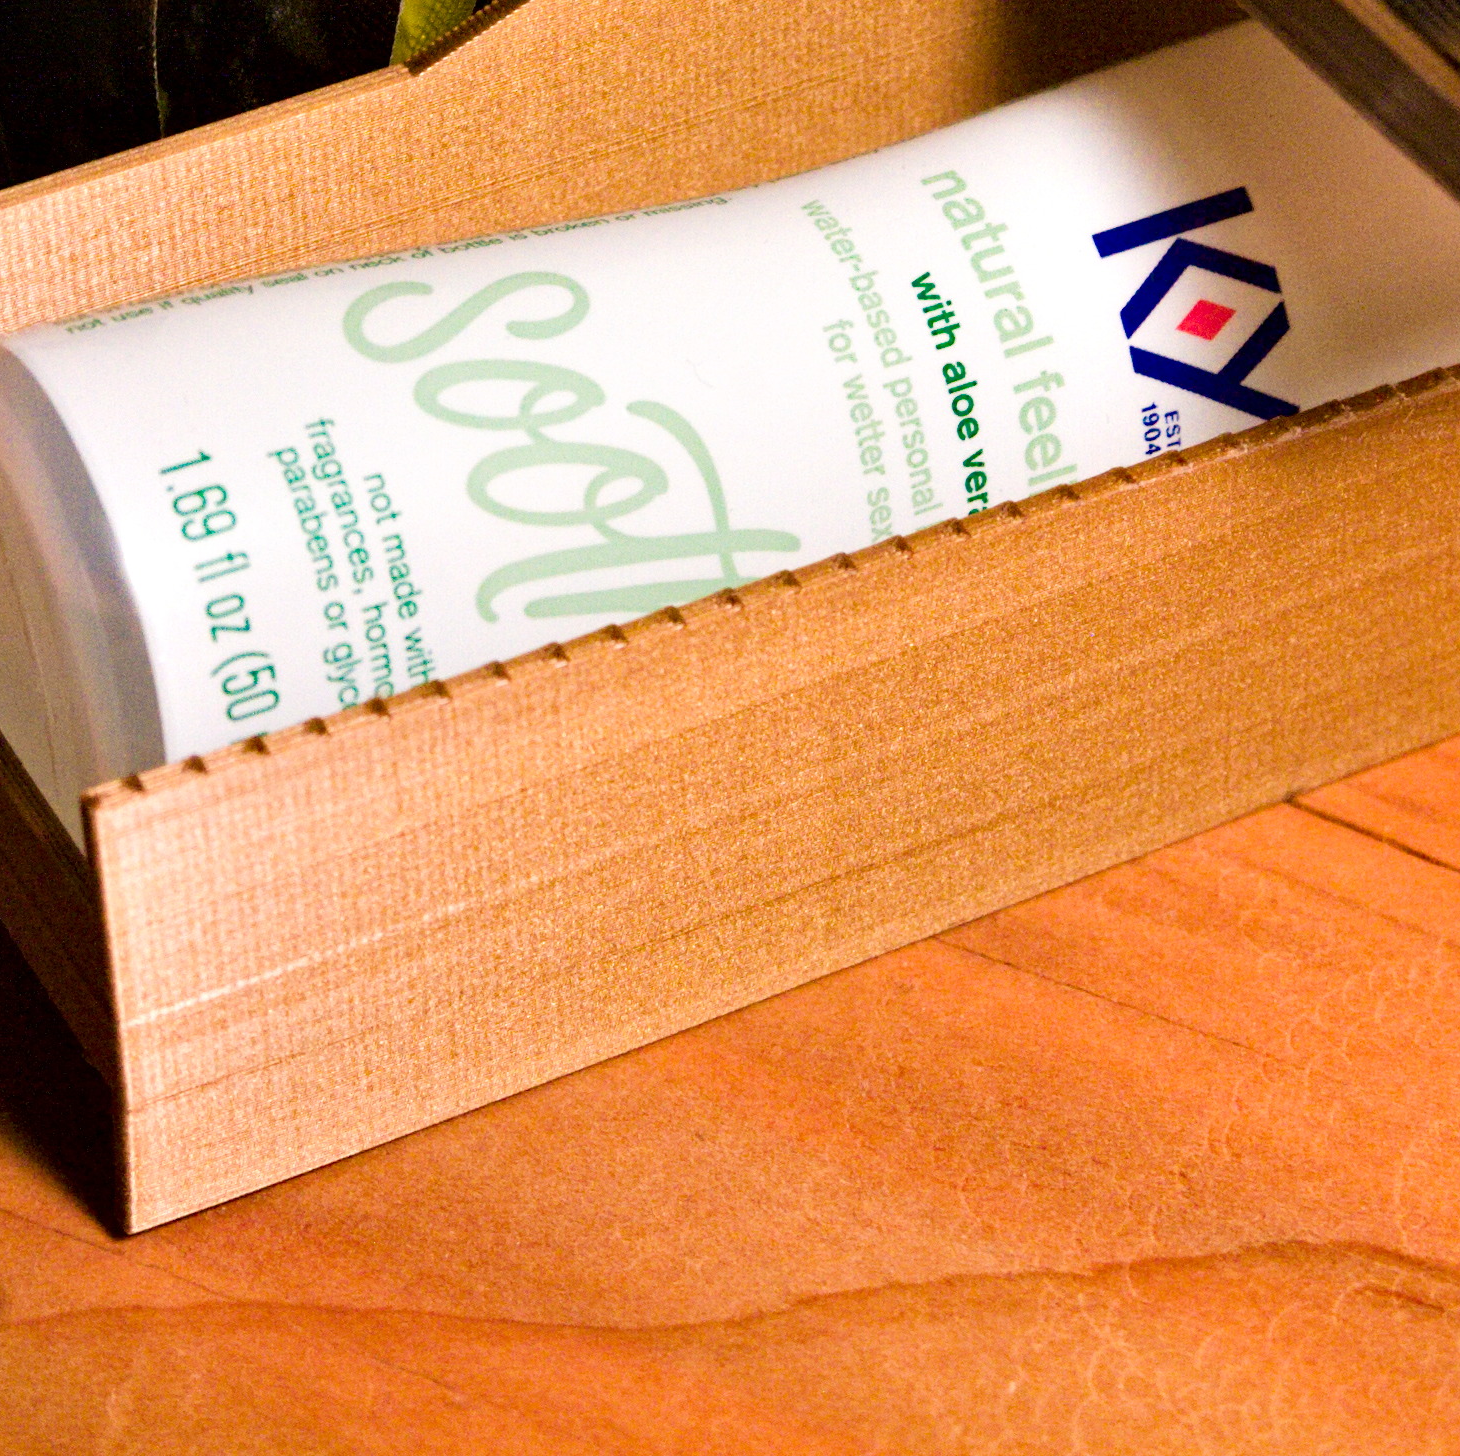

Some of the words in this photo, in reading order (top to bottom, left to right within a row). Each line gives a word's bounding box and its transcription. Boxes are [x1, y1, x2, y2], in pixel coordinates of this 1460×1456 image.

[530, 217, 610, 238] broken
[801, 199, 912, 369] water-based
[883, 377, 944, 516] personal
[911, 272, 960, 350] with
[942, 360, 977, 441] aloe
[921, 169, 1054, 359] natural
[1013, 369, 1078, 499] feel
[158, 448, 238, 542] 1.69
[823, 318, 858, 363] for
[843, 373, 885, 476] wetter
[867, 486, 893, 543] sex
[1141, 402, 1161, 456] 1904
[194, 550, 252, 583] fl
[266, 446, 338, 592] parabens
[323, 600, 349, 630] or
[305, 417, 375, 595] fragrances,
[364, 472, 402, 525] not
[383, 533, 422, 620] made
[205, 592, 252, 643] oz
[210, 650, 281, 722] (50
